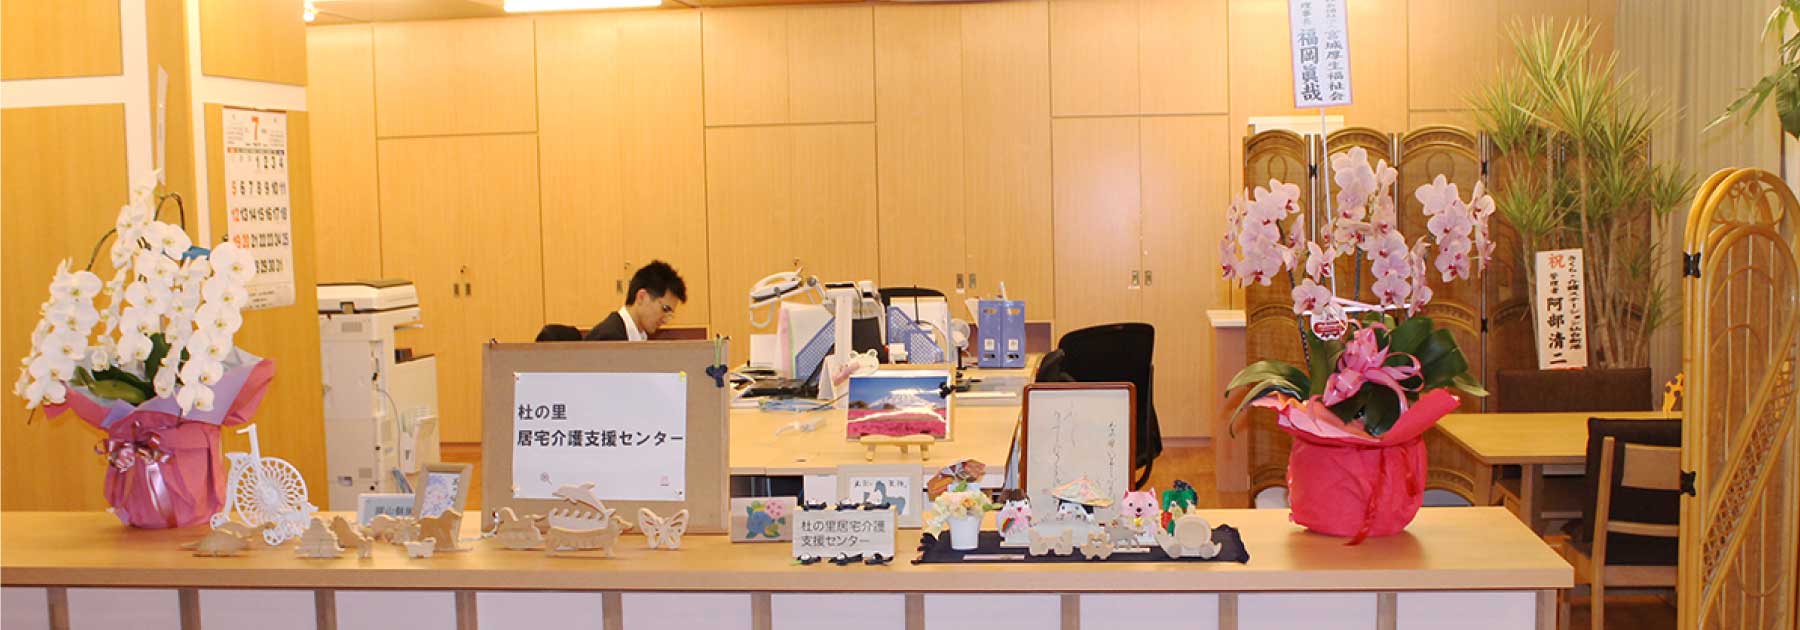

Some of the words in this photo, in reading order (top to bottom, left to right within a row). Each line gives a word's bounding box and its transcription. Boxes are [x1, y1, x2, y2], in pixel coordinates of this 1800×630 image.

[251, 116, 259, 141] 7
[1548, 254, 1565, 268] 祝
[1547, 297, 1567, 365] 阿部清二
[518, 404, 567, 421] 杜の里
[517, 430, 683, 447] 居宅介護支援センター
[801, 520, 885, 532] 杜の里居宅介護
[801, 535, 870, 547] 支援センター
